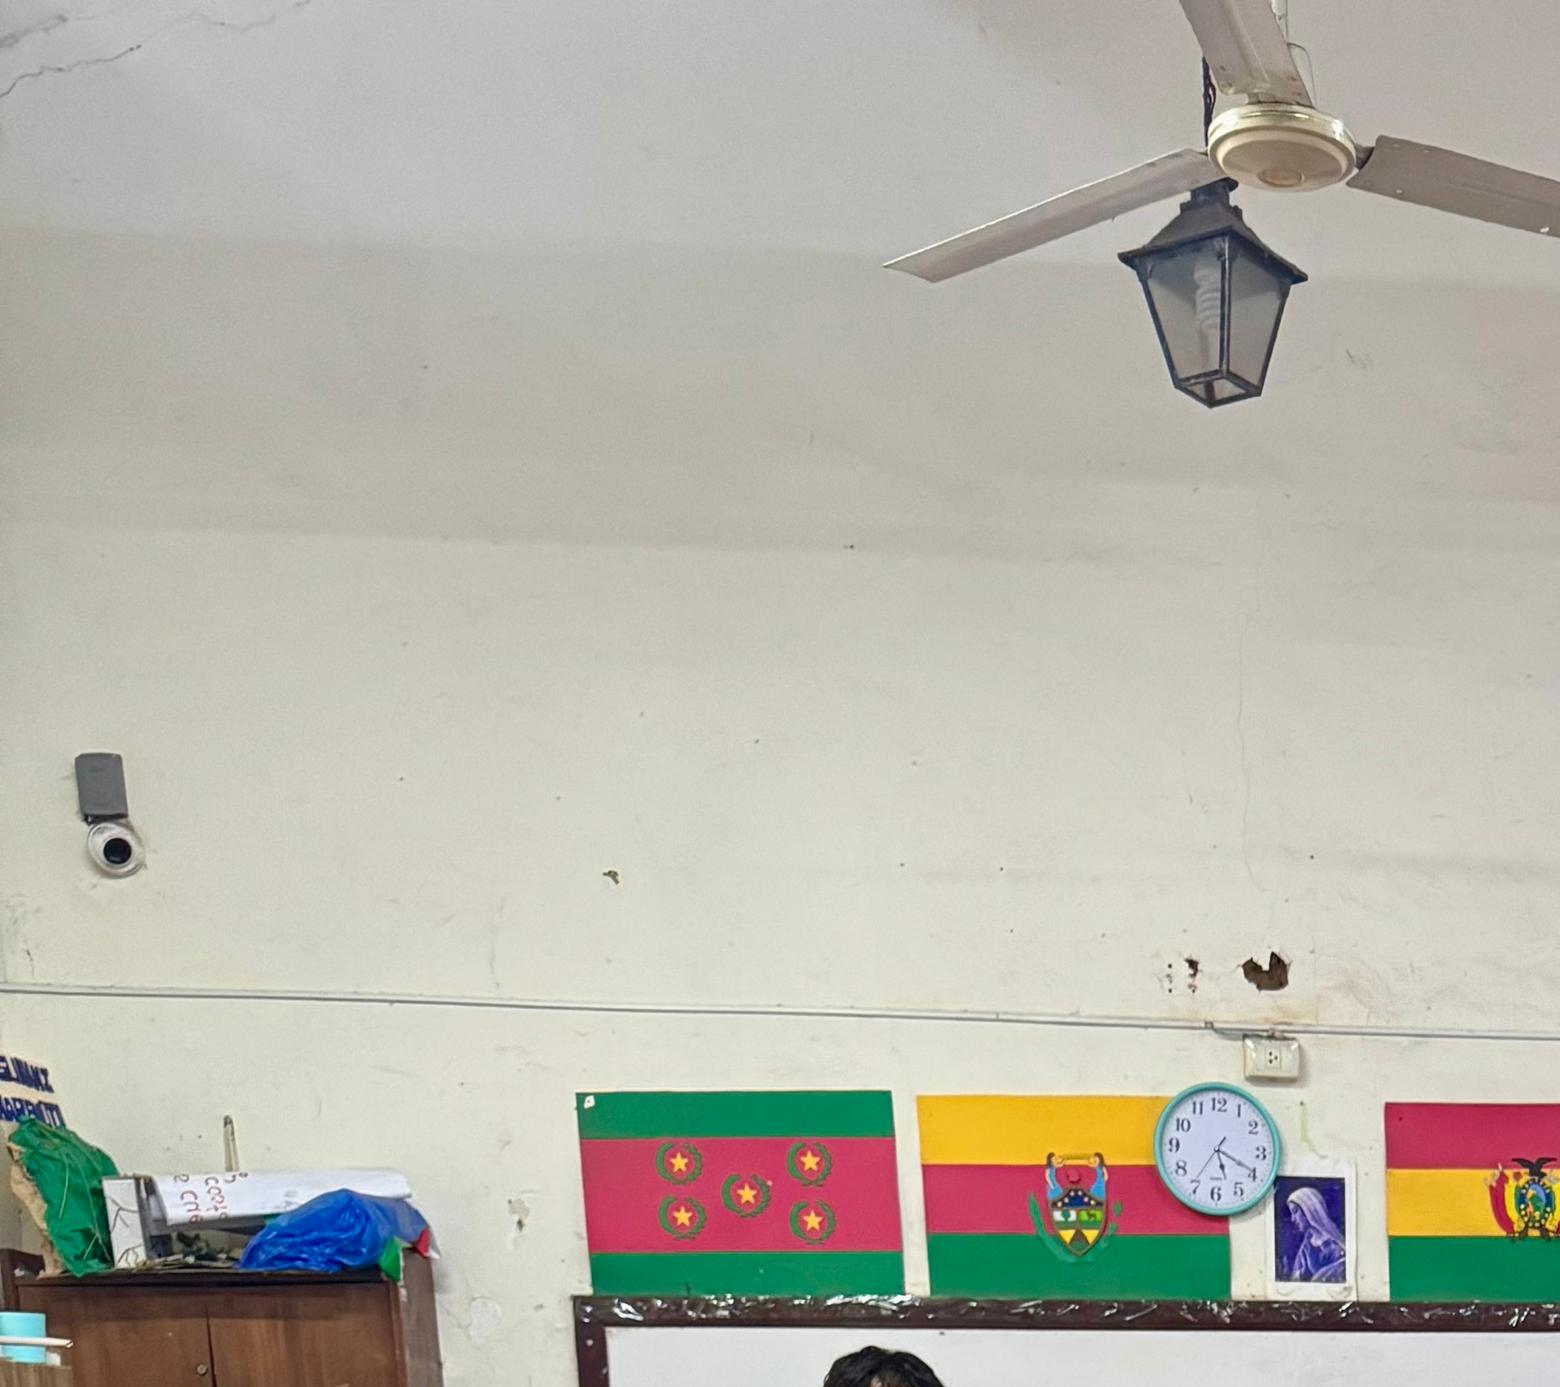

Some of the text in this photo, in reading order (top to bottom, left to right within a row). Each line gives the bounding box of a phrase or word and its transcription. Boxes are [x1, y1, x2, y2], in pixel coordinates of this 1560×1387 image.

[1192, 1101, 1203, 1115] 11
[1211, 1097, 1227, 1112] 12
[1175, 1118, 1191, 1132] 10
[1248, 1120, 1259, 1135] 2
[1168, 1138, 1180, 1153] 9
[1255, 1146, 1267, 1161] 3
[1175, 1160, 1187, 1176] 8
[1248, 1168, 1257, 1182] 4
[1190, 1179, 1200, 1195] 7
[1210, 1186, 1222, 1202] 6
[1233, 1182, 1244, 1197] 5
